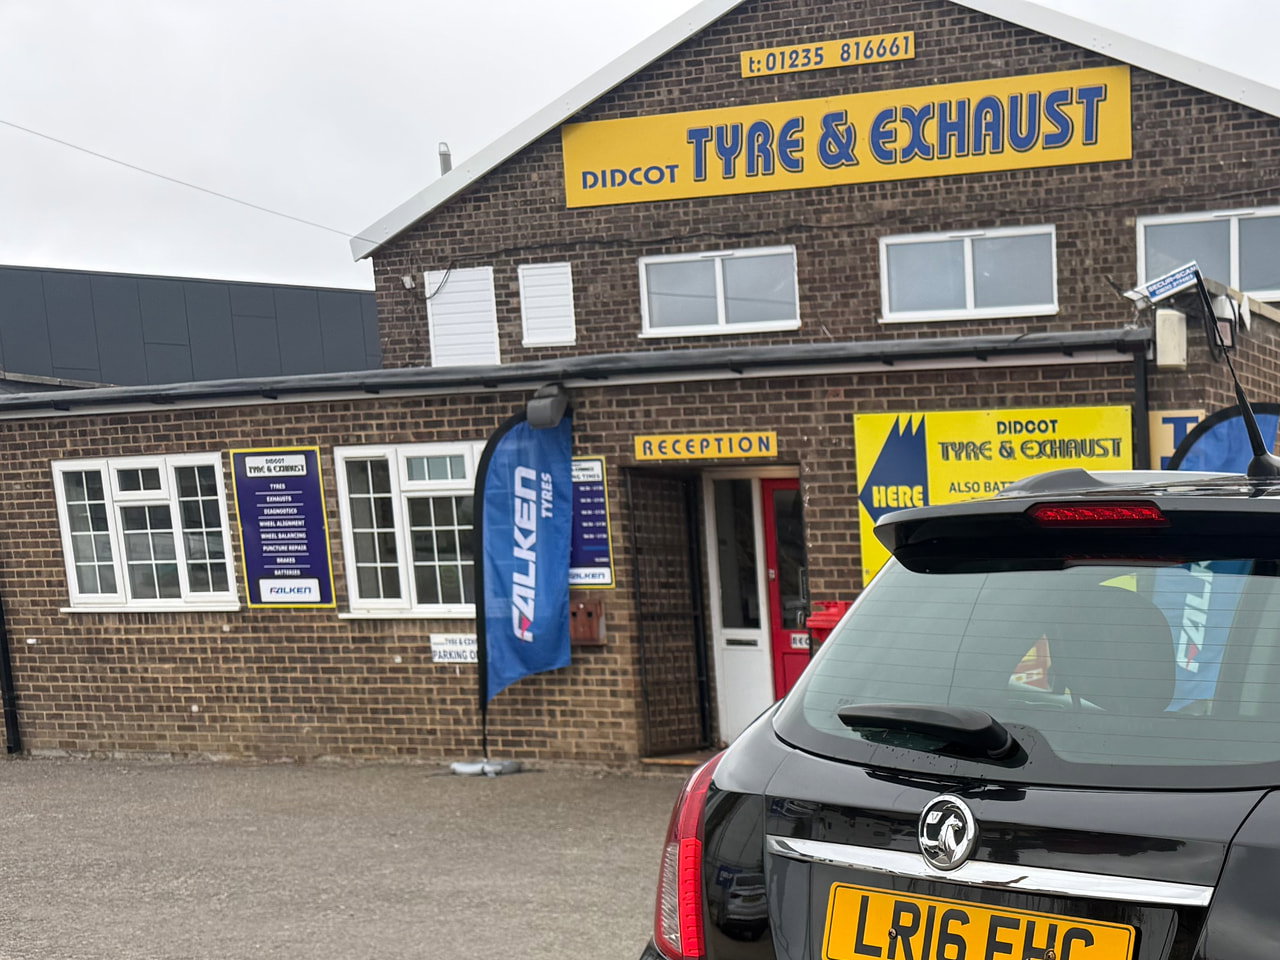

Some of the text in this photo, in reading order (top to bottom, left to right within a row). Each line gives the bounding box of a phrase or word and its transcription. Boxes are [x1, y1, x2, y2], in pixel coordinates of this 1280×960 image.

[749, 36, 909, 73] t:01235 816661
[581, 83, 1107, 191] DIDCOT TYRE & EXHAUST
[997, 419, 1058, 435] DIDCOT
[643, 435, 771, 456] RECEPTION
[938, 437, 1122, 462] TYRE & EXHAUST
[541, 472, 553, 519] TYRES
[872, 484, 924, 508] HERE
[949, 481, 980, 494] ALSO
[266, 495, 292, 503] EXHAUSTS
[511, 465, 537, 643] FALKEN
[270, 586, 312, 594] FALKEN
[432, 649, 468, 660] PARKING
